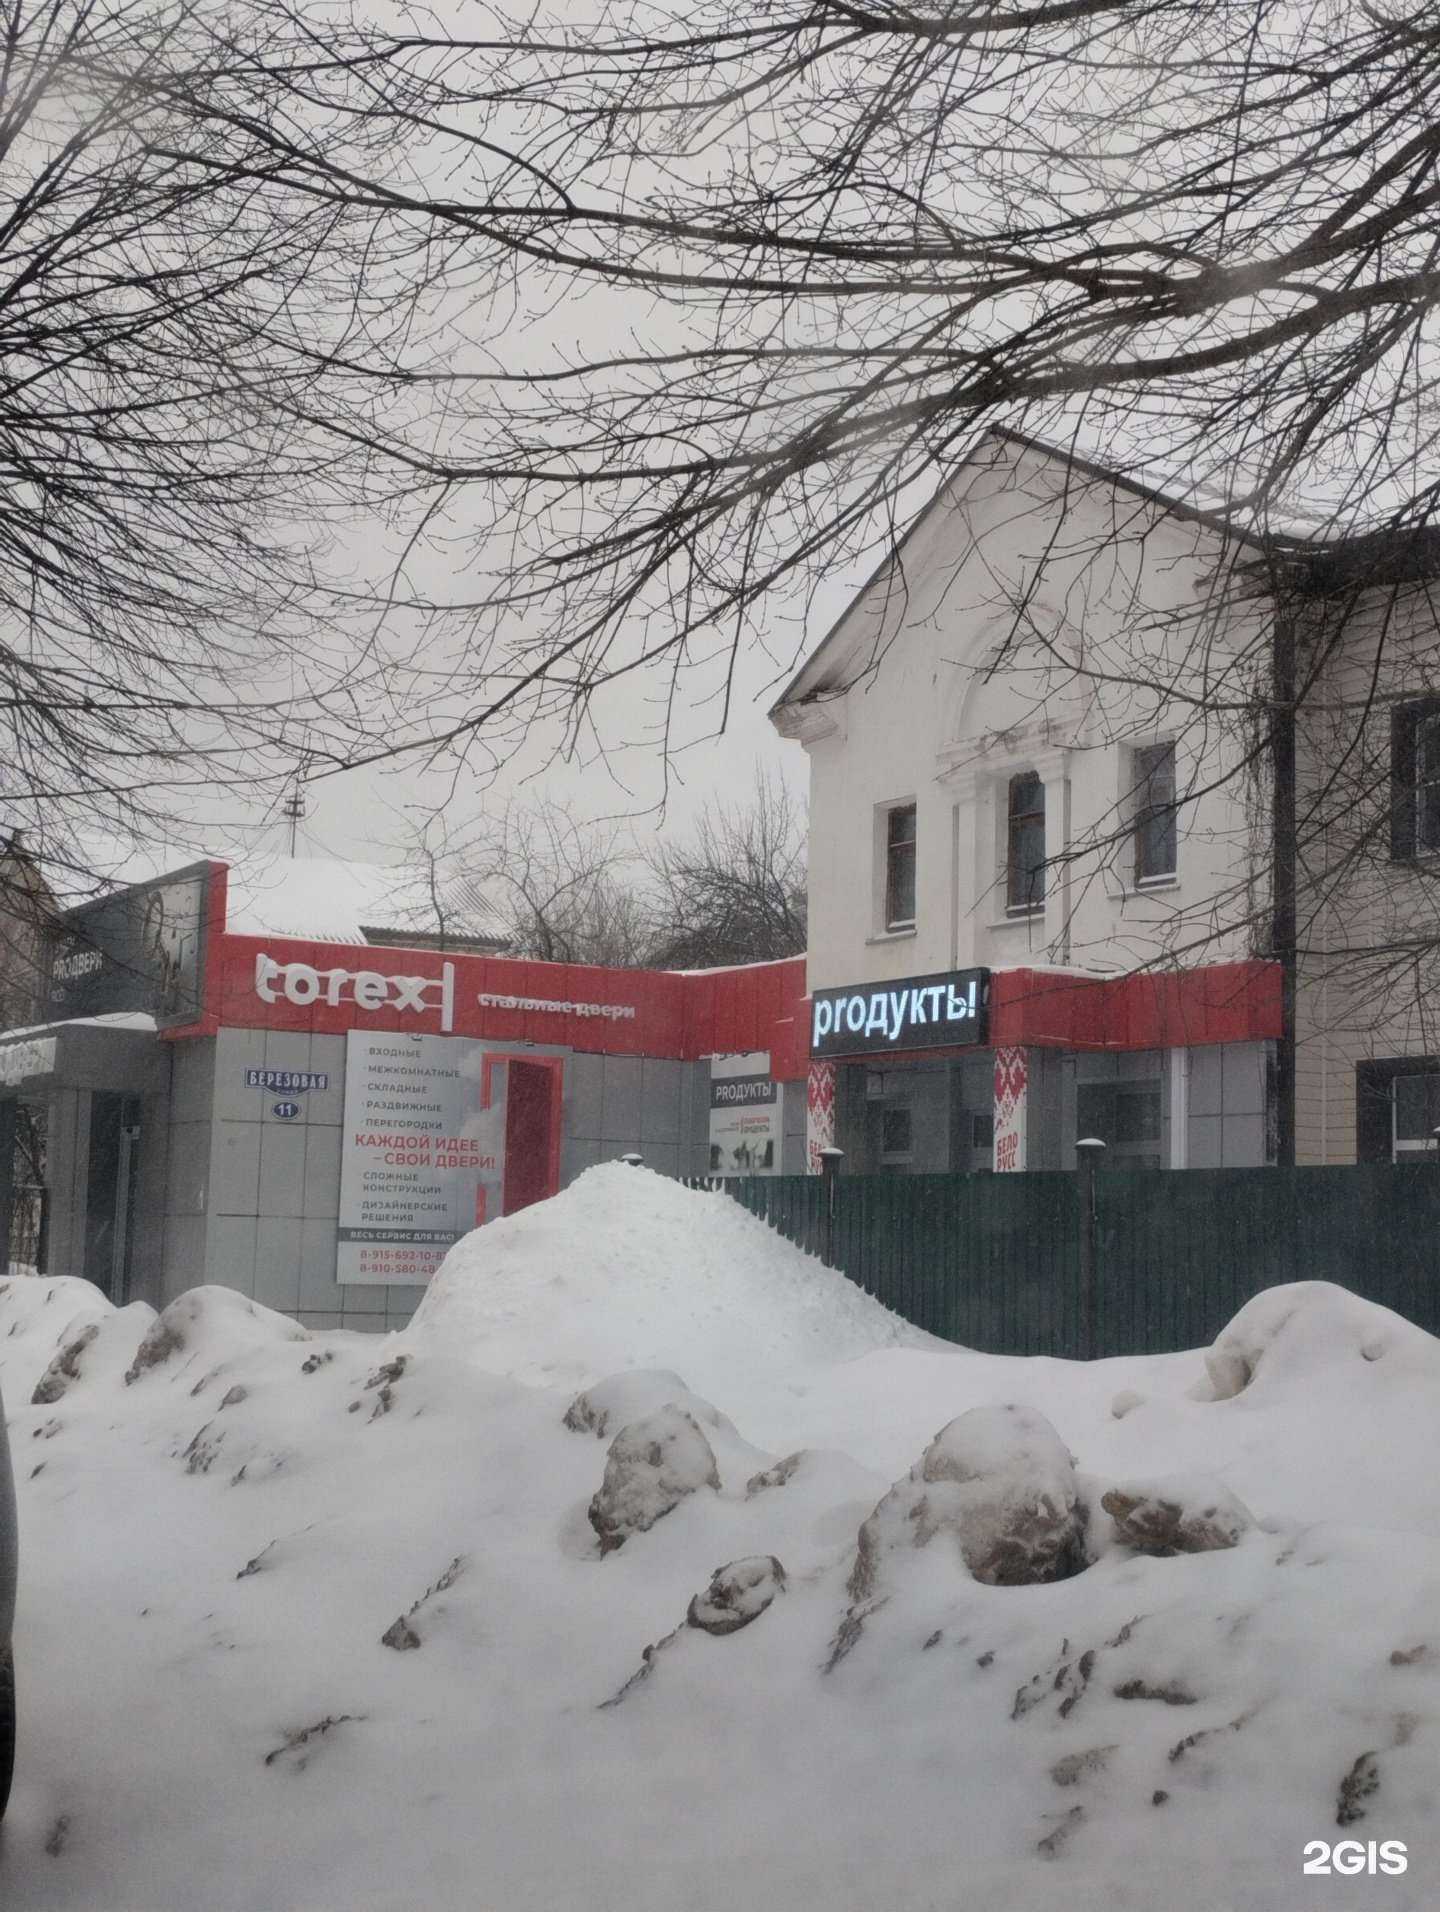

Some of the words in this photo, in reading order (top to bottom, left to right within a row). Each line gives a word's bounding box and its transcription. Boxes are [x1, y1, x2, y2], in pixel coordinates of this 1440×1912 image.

[256, 953, 427, 1013] torex
[478, 993, 571, 1013] стальные
[576, 1004, 635, 1020] двери
[369, 1047, 421, 1058] ВХОДНЫЕ
[368, 1065, 460, 1078] МЕЖКОМНАТНЫЕ
[250, 1071, 326, 1089] БЕРЕЗОВАЯ
[367, 1082, 428, 1094] СКЛАДНЫЕ
[278, 1103, 292, 1116] 11
[366, 1100, 442, 1112] РАЗДВИЖНЫЕ
[365, 1118, 443, 1130] ПЕРЕГОРОДКИ
[355, 1133, 431, 1150] КАЖДОЙ
[435, 1137, 478, 1152] ИДЕЕ
[435, 1154, 496, 1169] ДВЕРИ!
[363, 1171, 419, 1181] СЛОЖНЫЕ
[363, 1184, 442, 1194] КОНСТРУКЦИИ
[362, 1200, 448, 1212] ДИЗАЙНЕРСКИЕ
[361, 1212, 415, 1223] РЕШЕНИЯ
[350, 1231, 374, 1239] ВЕСЬ
[376, 1231, 411, 1240] СЕРВИС
[413, 1233, 432, 1241] ДЛЯ
